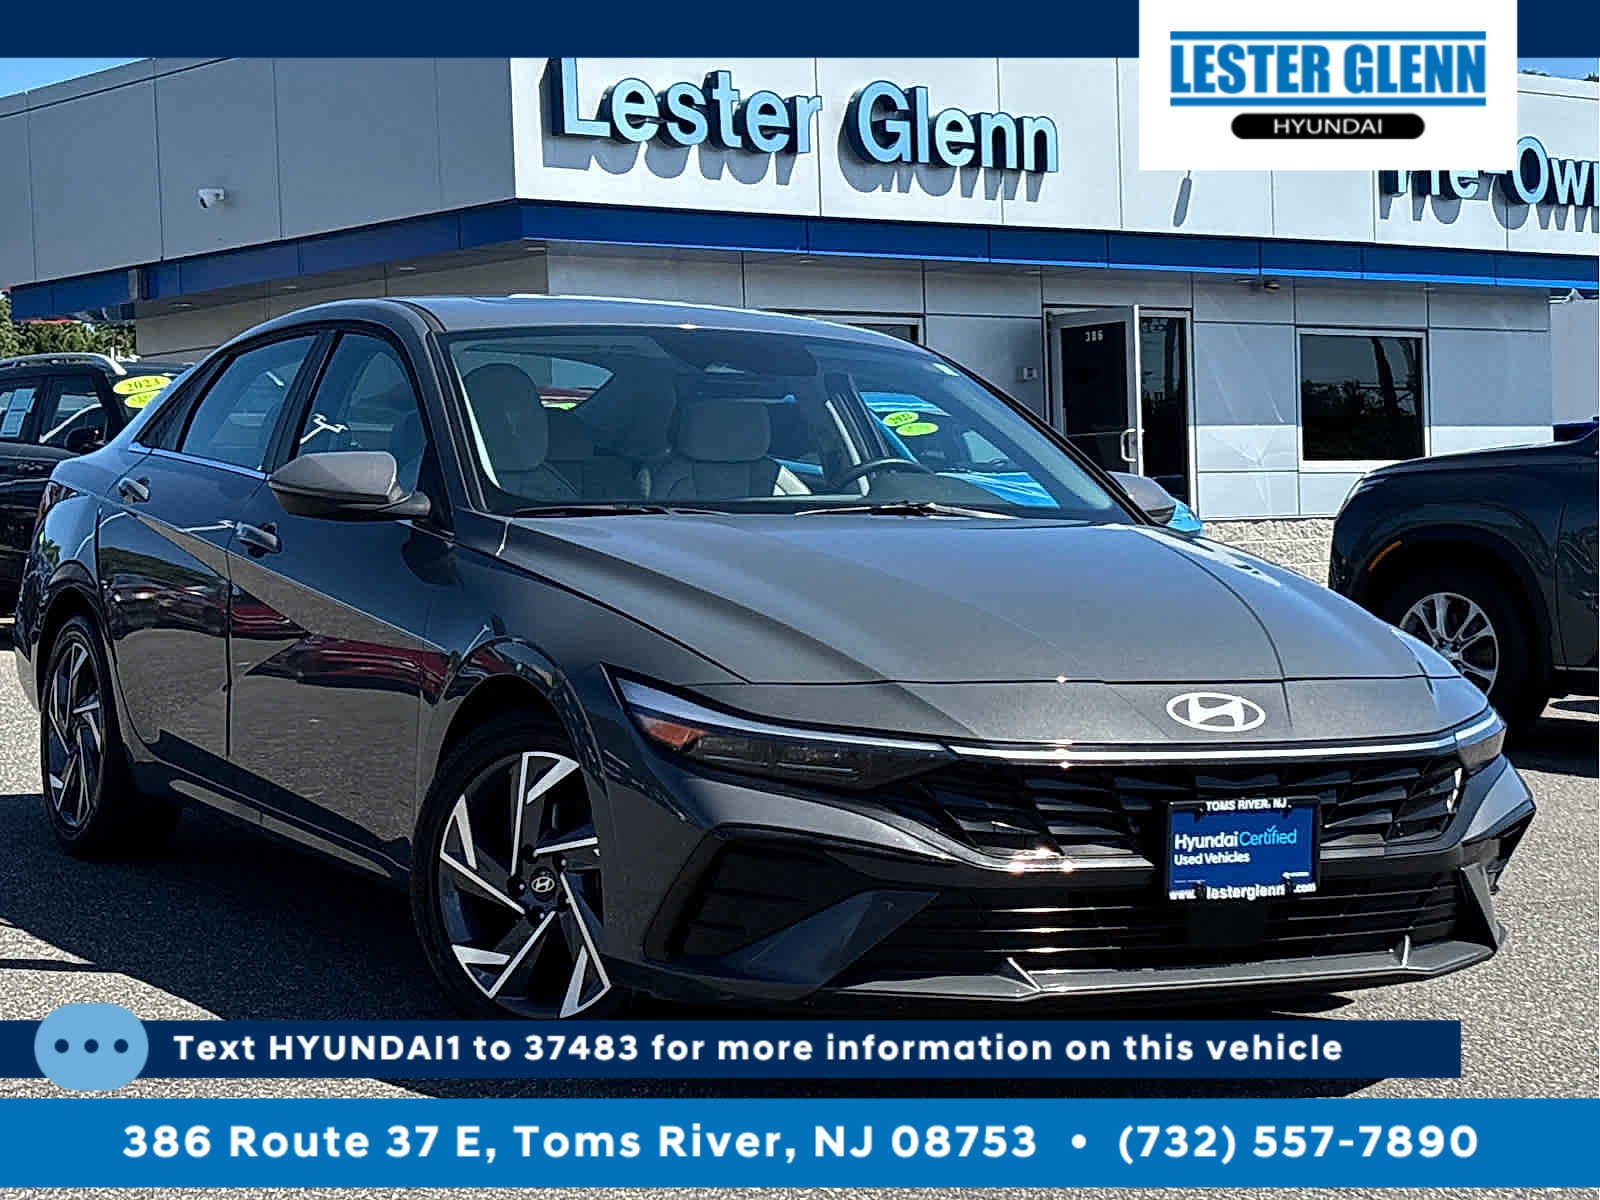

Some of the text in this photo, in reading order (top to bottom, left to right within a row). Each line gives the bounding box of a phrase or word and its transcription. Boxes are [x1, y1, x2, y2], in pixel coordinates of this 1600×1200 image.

[556, 57, 1059, 173] Lester Glenn
[1206, 800, 1236, 812] TOMS
[1174, 851, 1251, 866] Used Vehicles
[1206, 883, 1286, 901] lesterglenn
